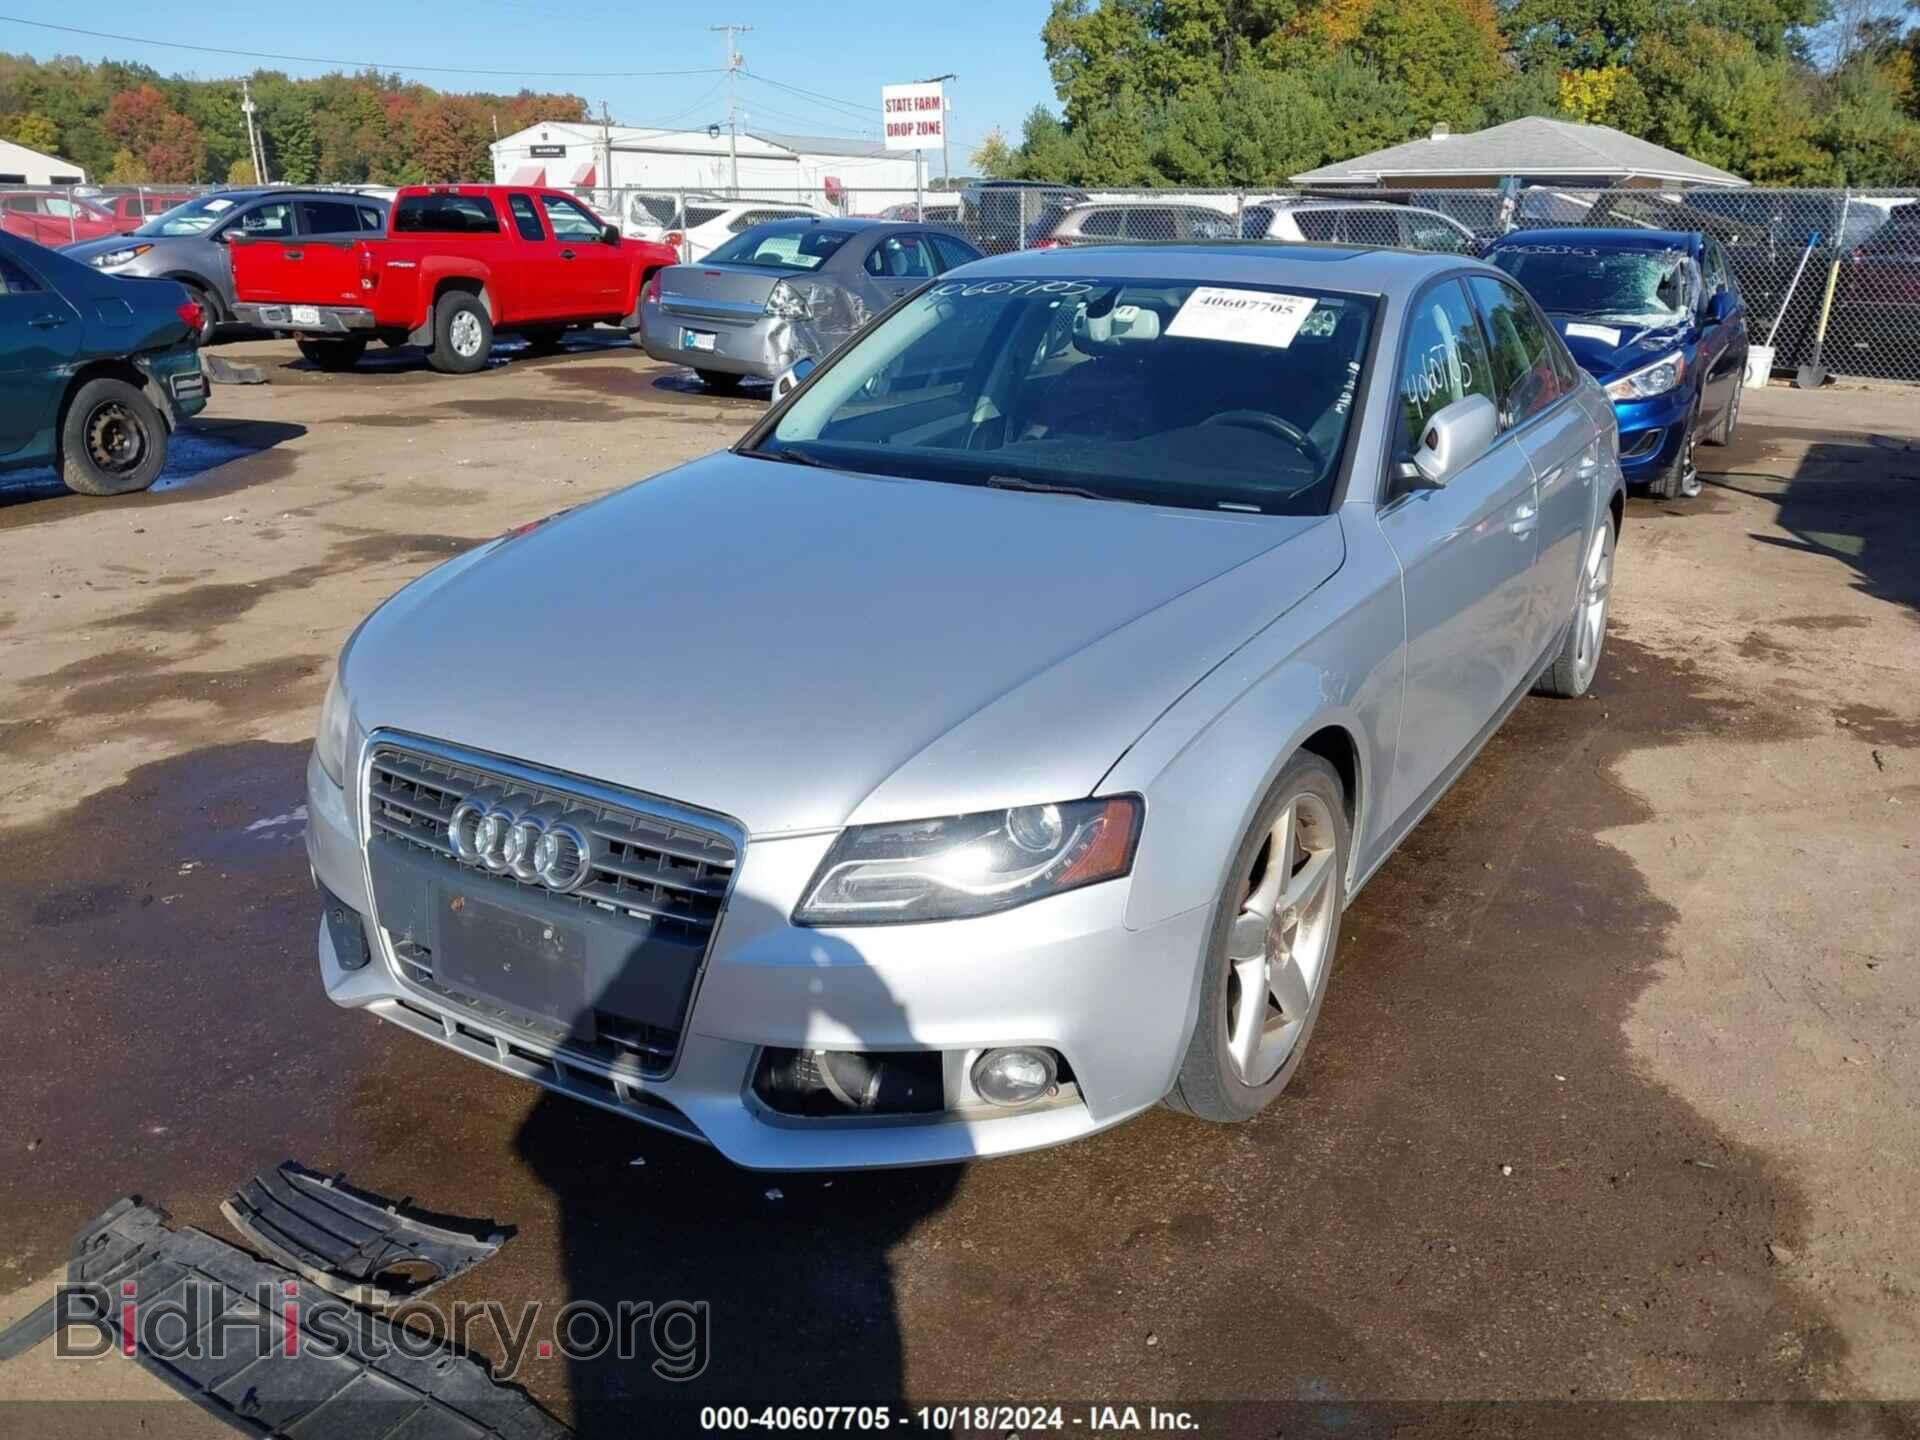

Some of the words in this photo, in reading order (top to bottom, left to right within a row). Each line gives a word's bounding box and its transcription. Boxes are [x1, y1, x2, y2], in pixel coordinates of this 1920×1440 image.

[886, 98, 912, 113] STATE
[914, 96, 940, 111] FARM
[887, 123, 913, 137] DROP
[916, 121, 941, 136] ZONE
[1200, 296, 1297, 315] 40607705
